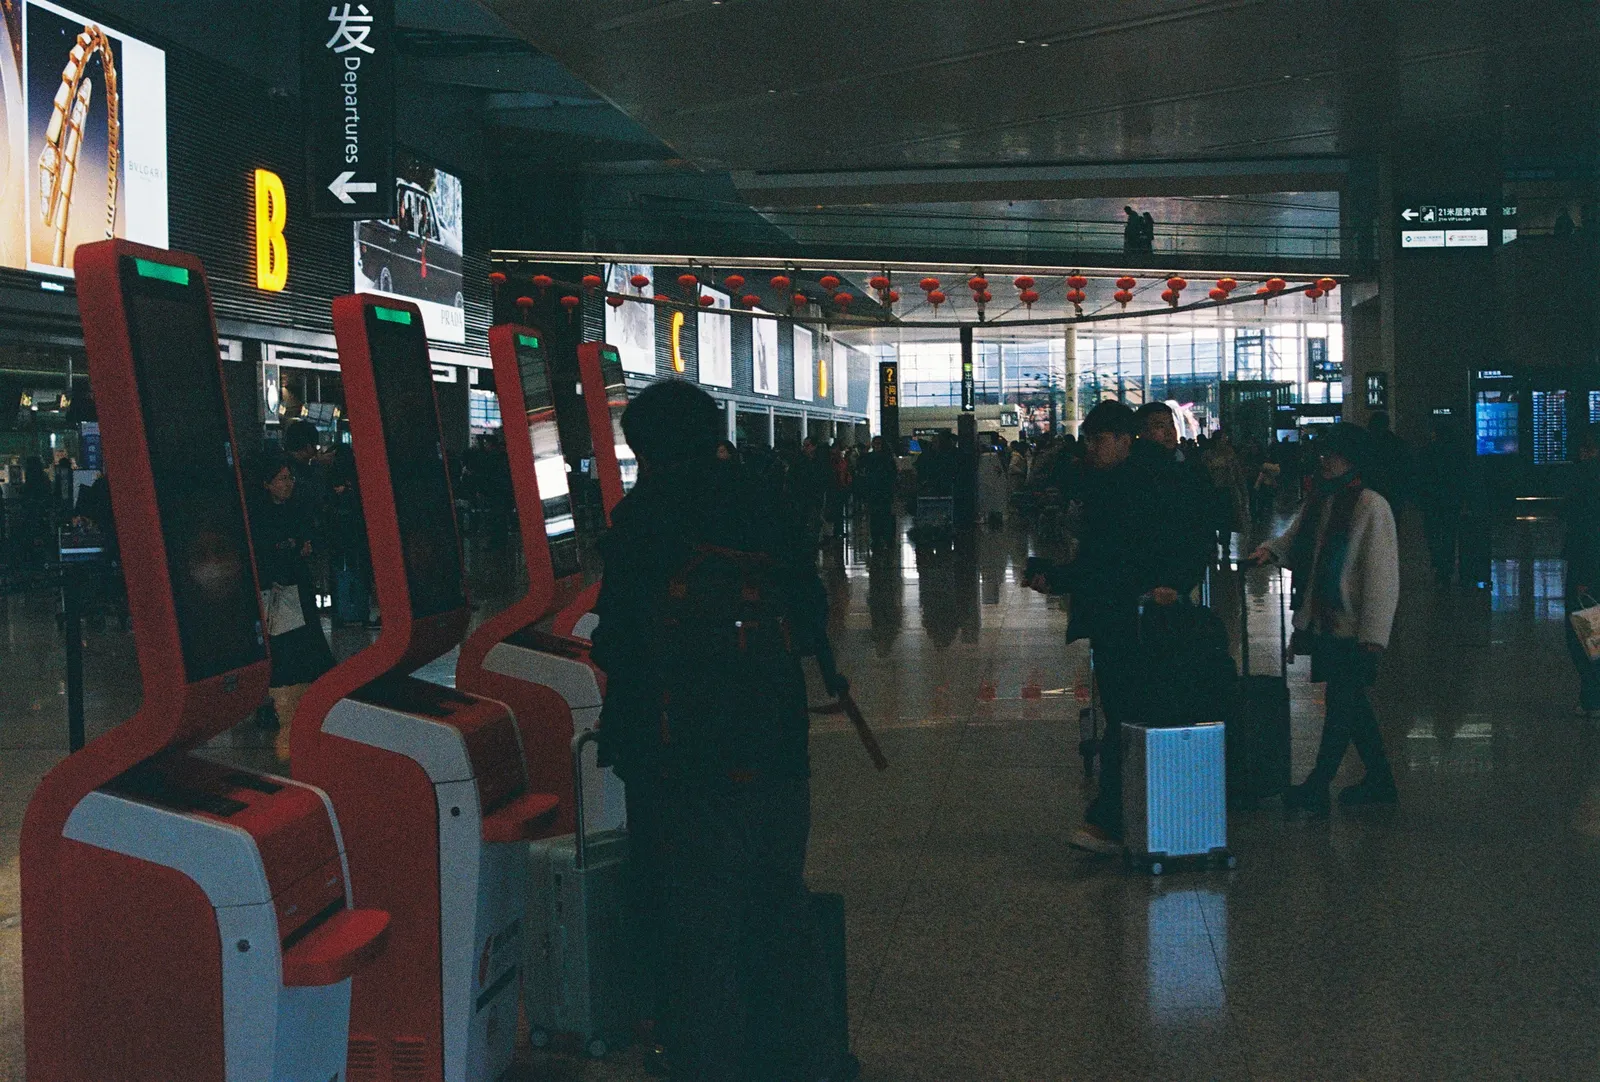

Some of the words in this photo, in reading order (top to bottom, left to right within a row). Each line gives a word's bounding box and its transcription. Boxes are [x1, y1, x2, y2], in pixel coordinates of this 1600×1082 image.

[325, 3, 376, 54] 发
[341, 57, 361, 163] Departures
[254, 168, 288, 292] B
[1438, 207, 1487, 216] 21米层贵宾室
[440, 309, 463, 329] PRADA
[671, 311, 685, 373] C
